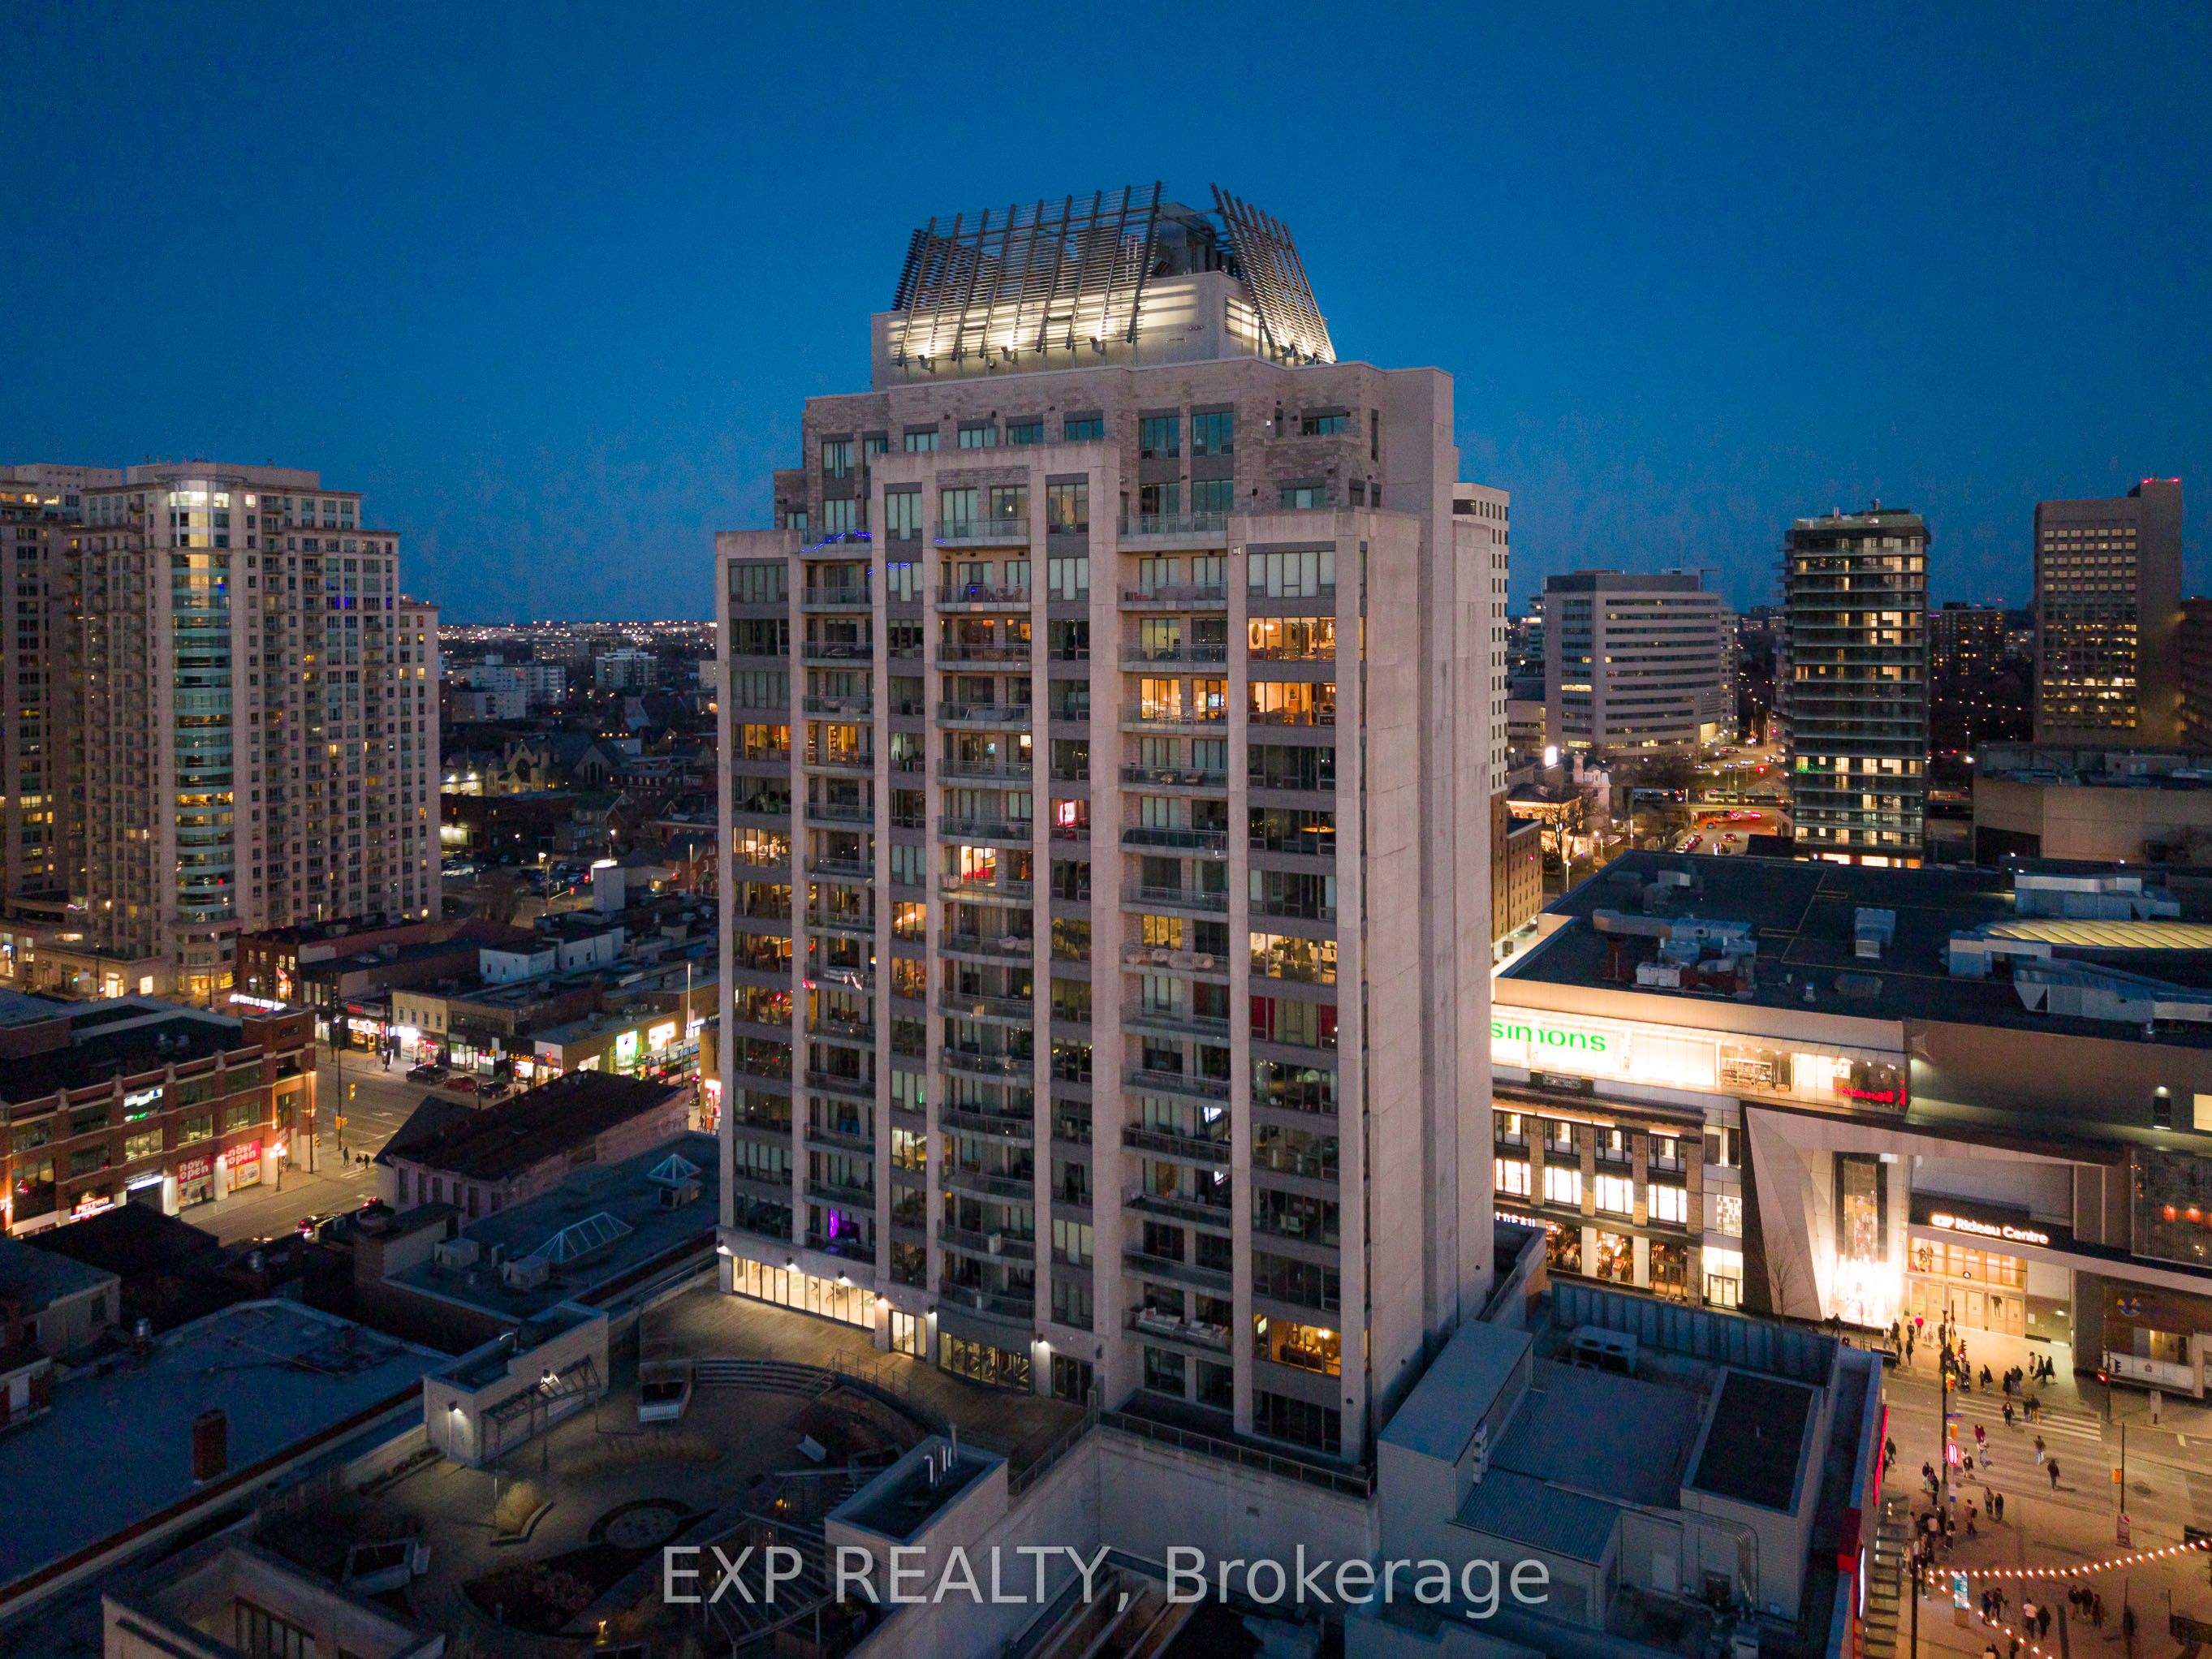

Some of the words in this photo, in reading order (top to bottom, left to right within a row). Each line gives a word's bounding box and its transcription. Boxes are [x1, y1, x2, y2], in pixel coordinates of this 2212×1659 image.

[1490, 1021, 1606, 1053] simons
[228, 1144, 252, 1157] now
[228, 1149, 257, 1166] open
[179, 1158, 205, 1172] now
[179, 1164, 209, 1181] open
[1955, 1217, 2001, 1237] Rideau
[2003, 1226, 2050, 1245] Centre
